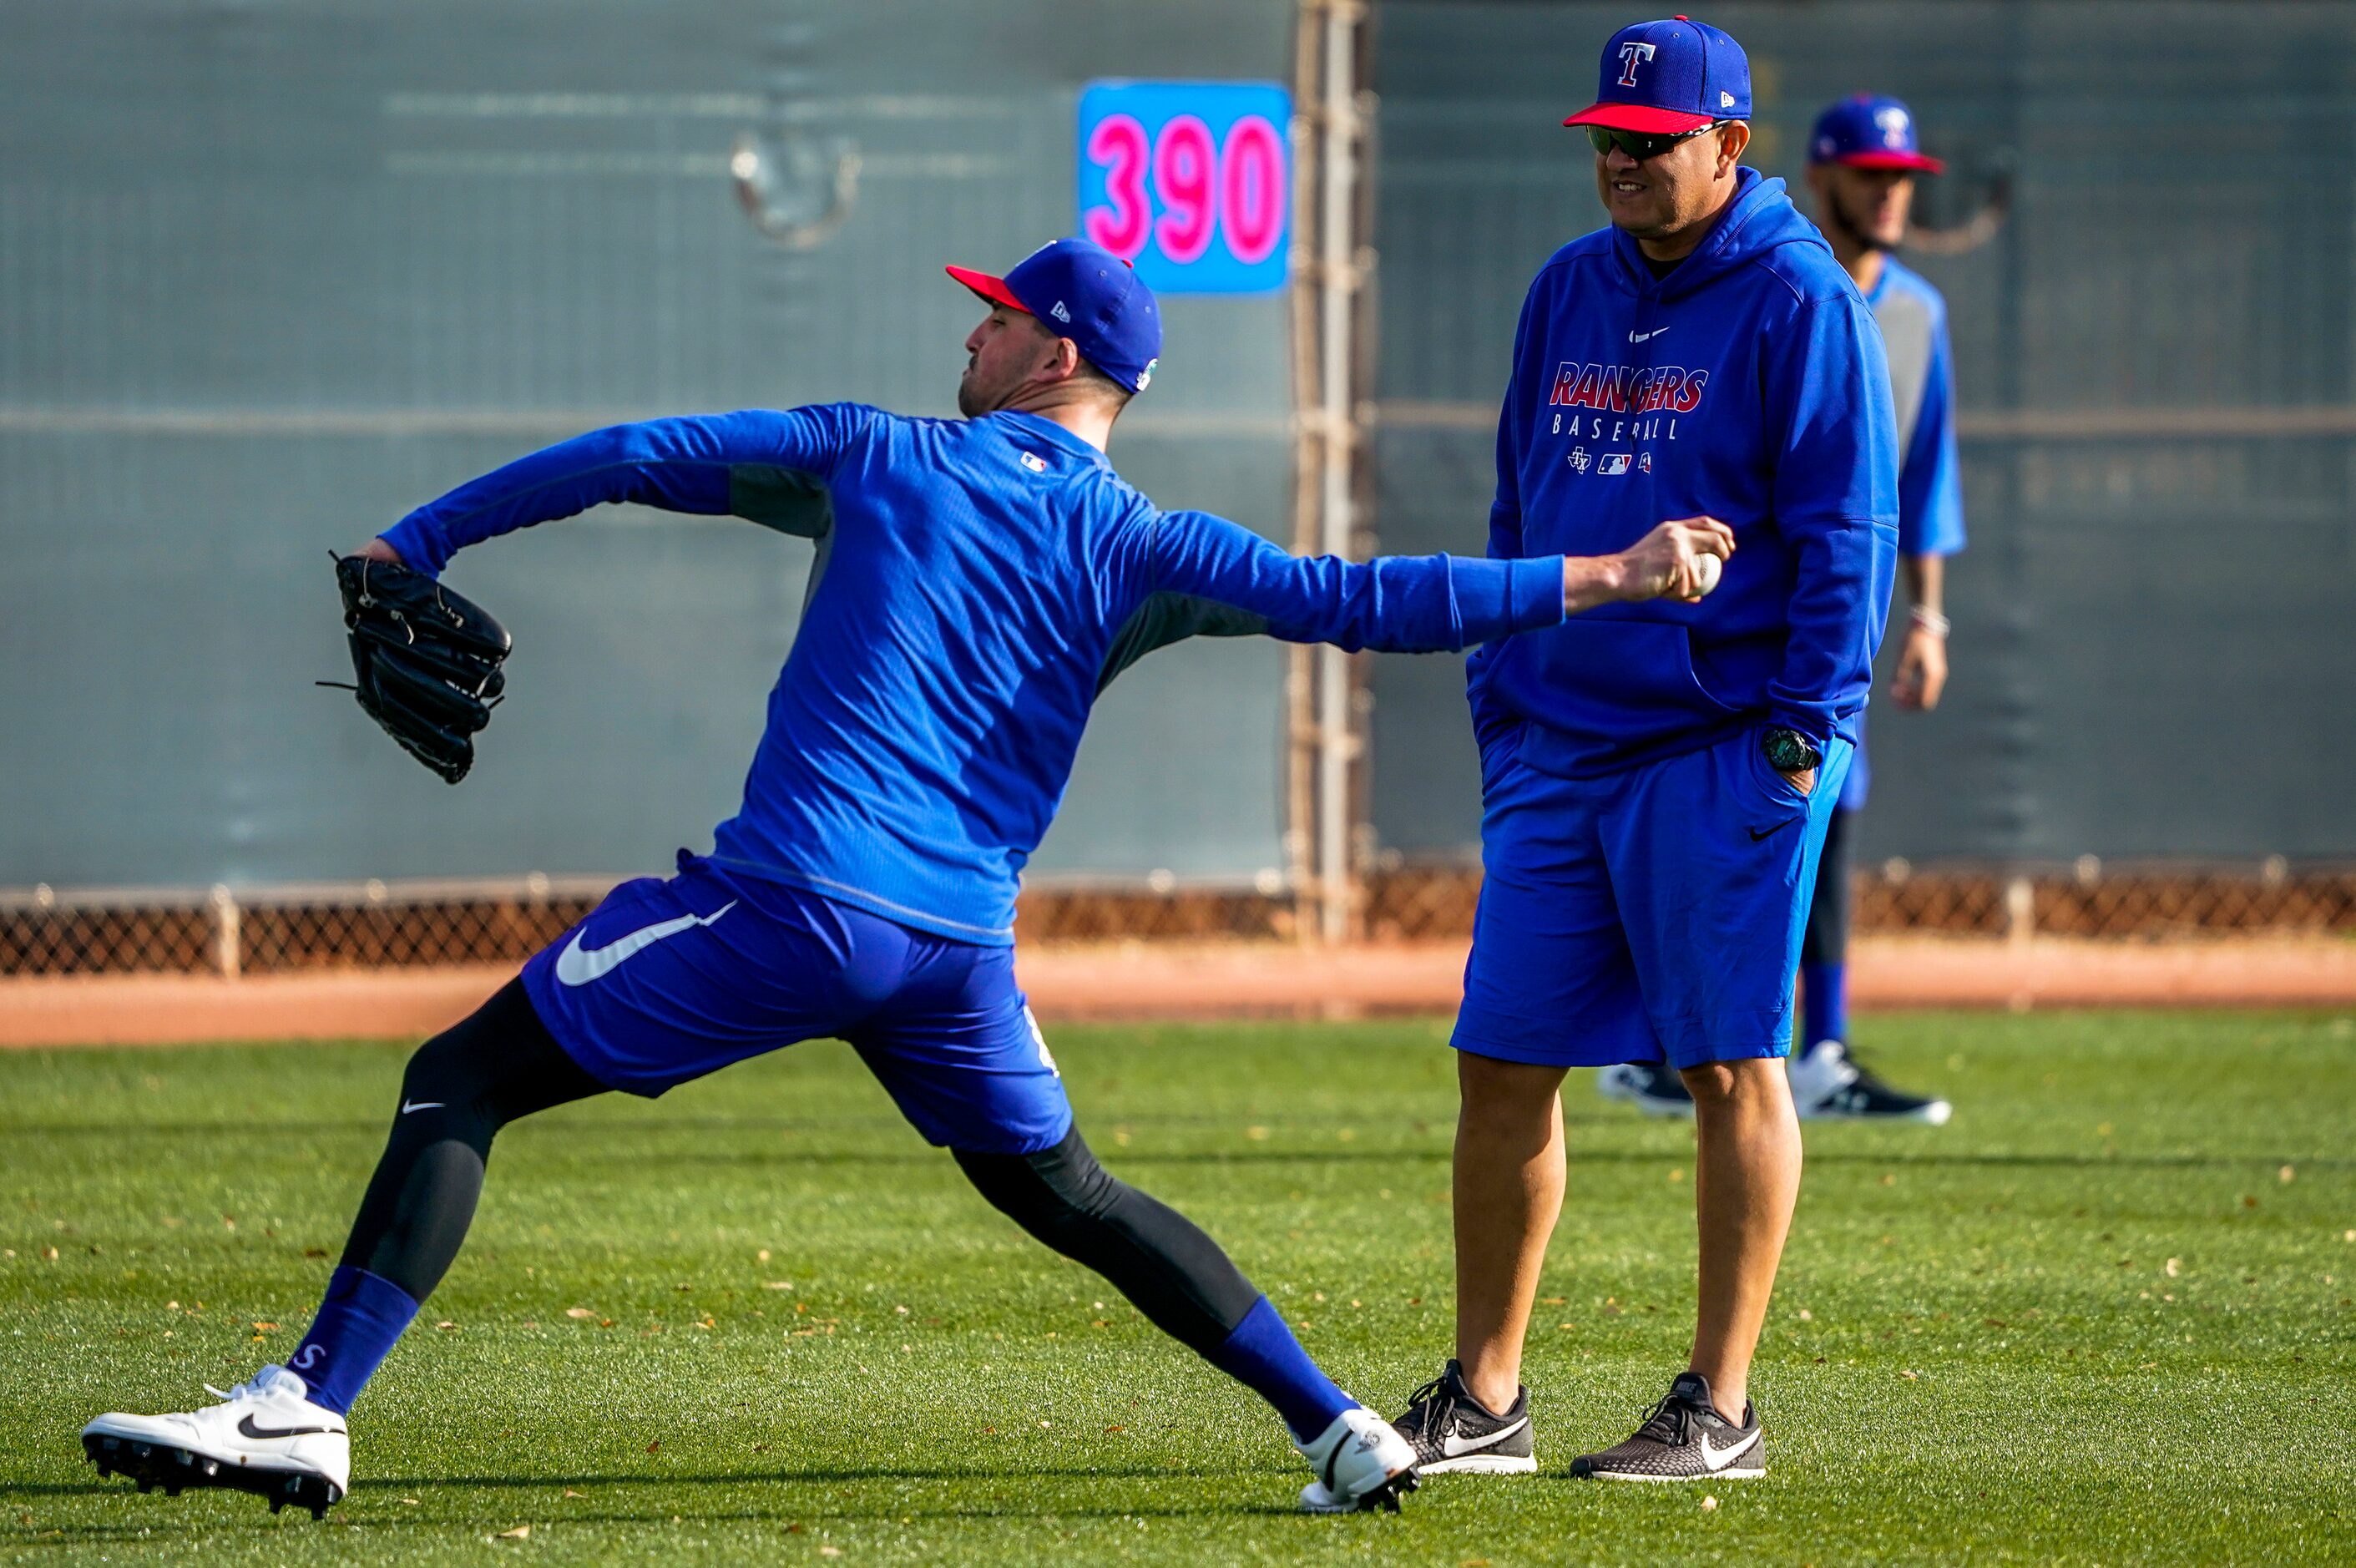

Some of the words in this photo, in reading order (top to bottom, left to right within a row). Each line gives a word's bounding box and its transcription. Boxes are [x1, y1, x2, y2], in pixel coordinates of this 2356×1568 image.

[1617, 42, 1656, 88] T
[1084, 113, 1286, 266] 390
[1550, 362, 1709, 414] RANGERS
[1552, 413, 1676, 442] BASEBALL
[293, 1343, 326, 1369] S
